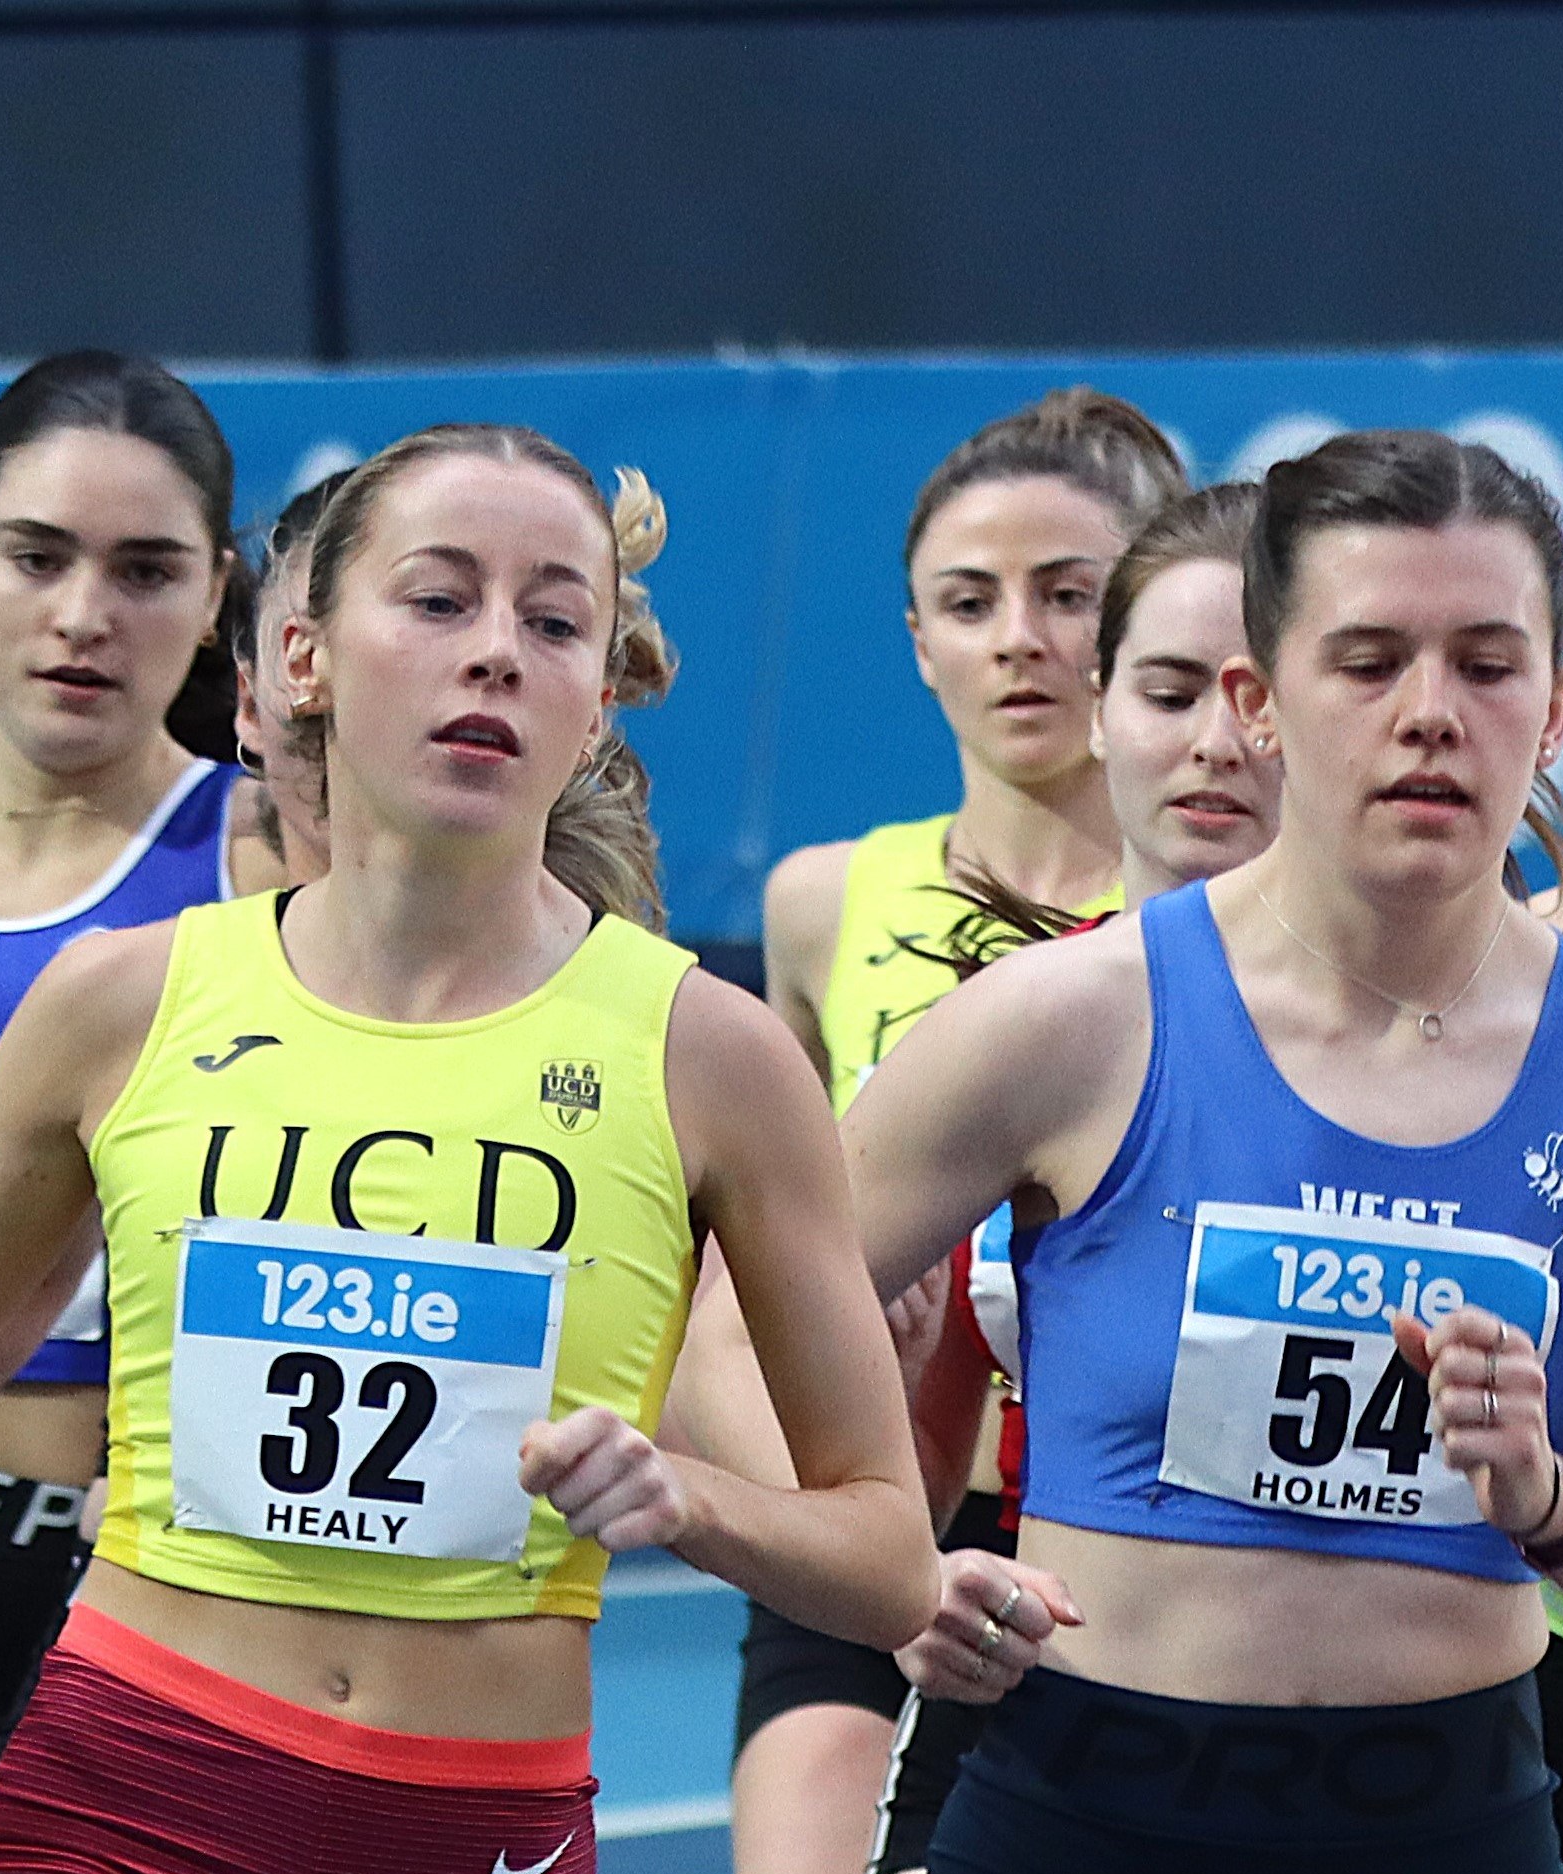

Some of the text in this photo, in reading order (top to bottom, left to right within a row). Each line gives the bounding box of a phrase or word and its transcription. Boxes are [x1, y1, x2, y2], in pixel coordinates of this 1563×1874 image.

[547, 1075, 595, 1097] UCD
[200, 1125, 577, 1254] UCD
[257, 1260, 460, 1343] 123.ie
[260, 1351, 438, 1505] 32
[1269, 1334, 1434, 1476] 54
[266, 1504, 409, 1546] HEALY
[1252, 1473, 1424, 1516] HOLMES
